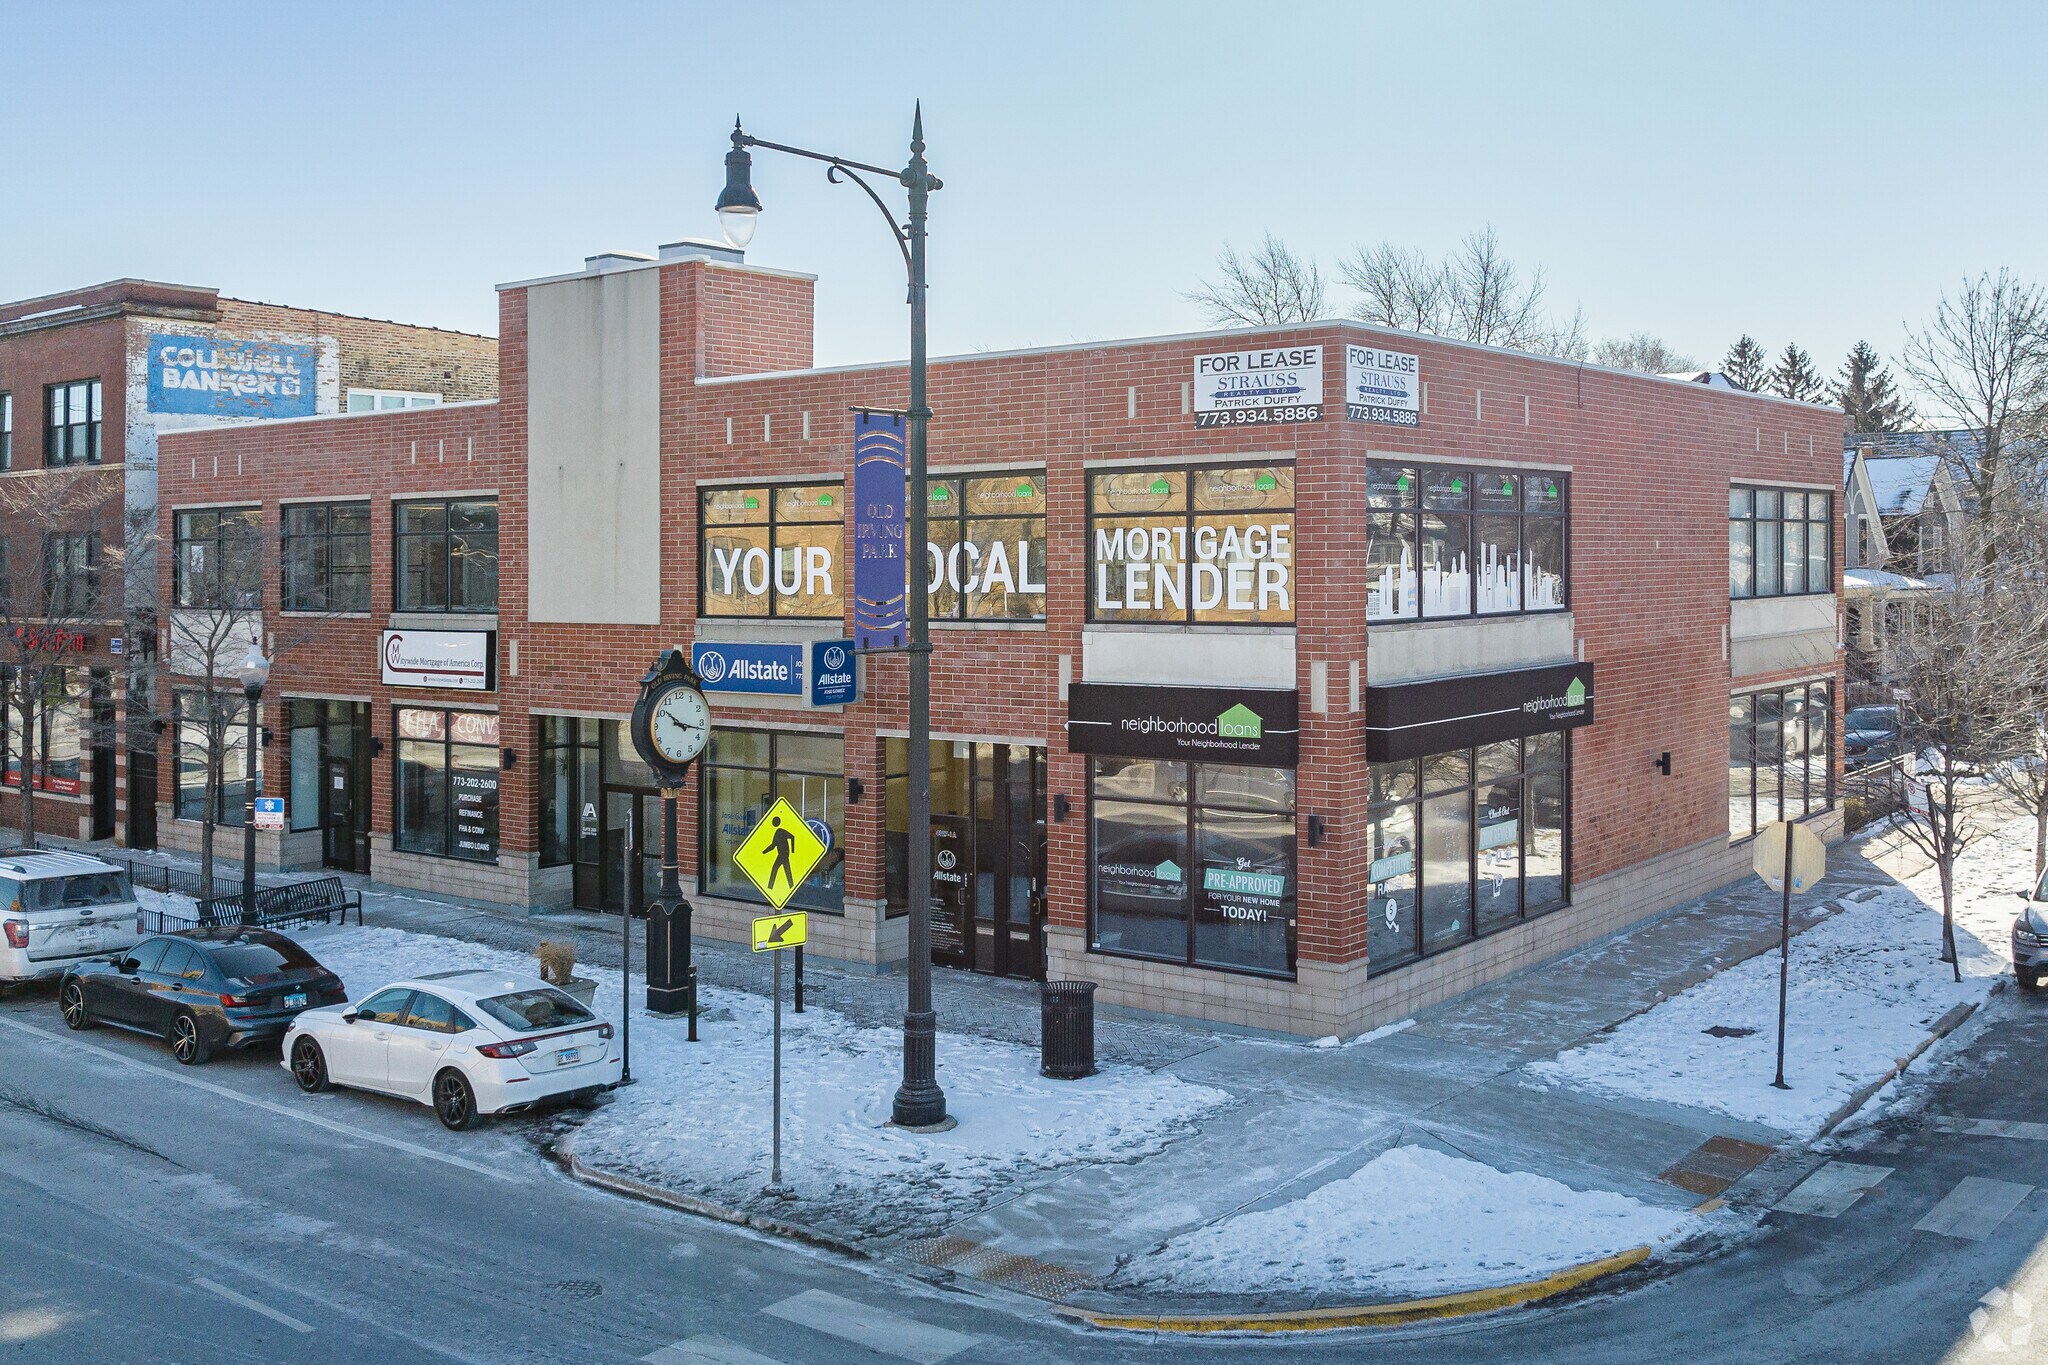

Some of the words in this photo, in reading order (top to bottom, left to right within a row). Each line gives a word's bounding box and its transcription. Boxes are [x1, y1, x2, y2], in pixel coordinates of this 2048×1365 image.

[1200, 354, 1240, 373] FOR
[1247, 349, 1317, 370] LEASE
[1349, 348, 1374, 368] FOR
[1378, 353, 1416, 373] LEASE
[1217, 371, 1298, 391] STRAUSS
[1360, 371, 1406, 390] STRAUSS
[1214, 398, 1260, 408] PATRICK
[1263, 395, 1302, 406] DUFFY
[1358, 393, 1386, 405] PATRICK
[1387, 396, 1409, 408] DUFFY
[1199, 406, 1319, 427] 773.934.5886
[1349, 405, 1418, 426] 773.934.5886
[867, 504, 894, 520] OLD
[857, 524, 903, 539] IRVING
[1096, 524, 1291, 562] MORTGAGE
[862, 544, 898, 559] PARK
[714, 546, 833, 596] YOUR
[906, 540, 1046, 594] OCAL
[1098, 562, 1291, 611] LENDER
[420, 657, 443, 669] Mortgage
[443, 658, 449, 667] of
[449, 657, 471, 668] America
[728, 659, 788, 681] Allstate
[651, 679, 663, 689] OLD
[663, 672, 683, 681] IRVING
[817, 672, 852, 686] Allstate
[664, 698, 672, 706] 11
[675, 692, 684, 700] 12
[689, 695, 693, 703] 1
[1523, 692, 1568, 714] neighborhood
[656, 710, 666, 718] 10
[695, 705, 701, 713] 2
[699, 719, 705, 727] 3
[1121, 716, 1218, 734] neighborhood
[1220, 717, 1259, 737] loans
[695, 733, 701, 741] 4
[1176, 737, 1191, 747] Your
[1191, 738, 1238, 750] Neighborhood
[1238, 740, 1261, 750] Lender
[677, 750, 682, 758] 6
[687, 745, 693, 753] 5
[453, 776, 497, 790] 773-202-2600
[458, 794, 483, 803] PURCHASE
[458, 808, 484, 819] REFINANCE
[458, 824, 468, 833] FHA
[471, 826, 485, 835] CONV
[458, 840, 475, 849] JUMBO
[474, 842, 490, 851] LOANS
[1236, 856, 1251, 871] Get
[933, 870, 961, 883] Allstate
[1098, 863, 1156, 878] neighborhood
[1156, 866, 1181, 882] loans
[1207, 872, 1281, 894] PRE-APPROVED
[1208, 891, 1222, 900] FOR
[1222, 893, 1241, 903] YOUR
[1242, 896, 1259, 905] NEW
[1259, 898, 1281, 907] HOME
[1220, 905, 1267, 922] TODAY!
